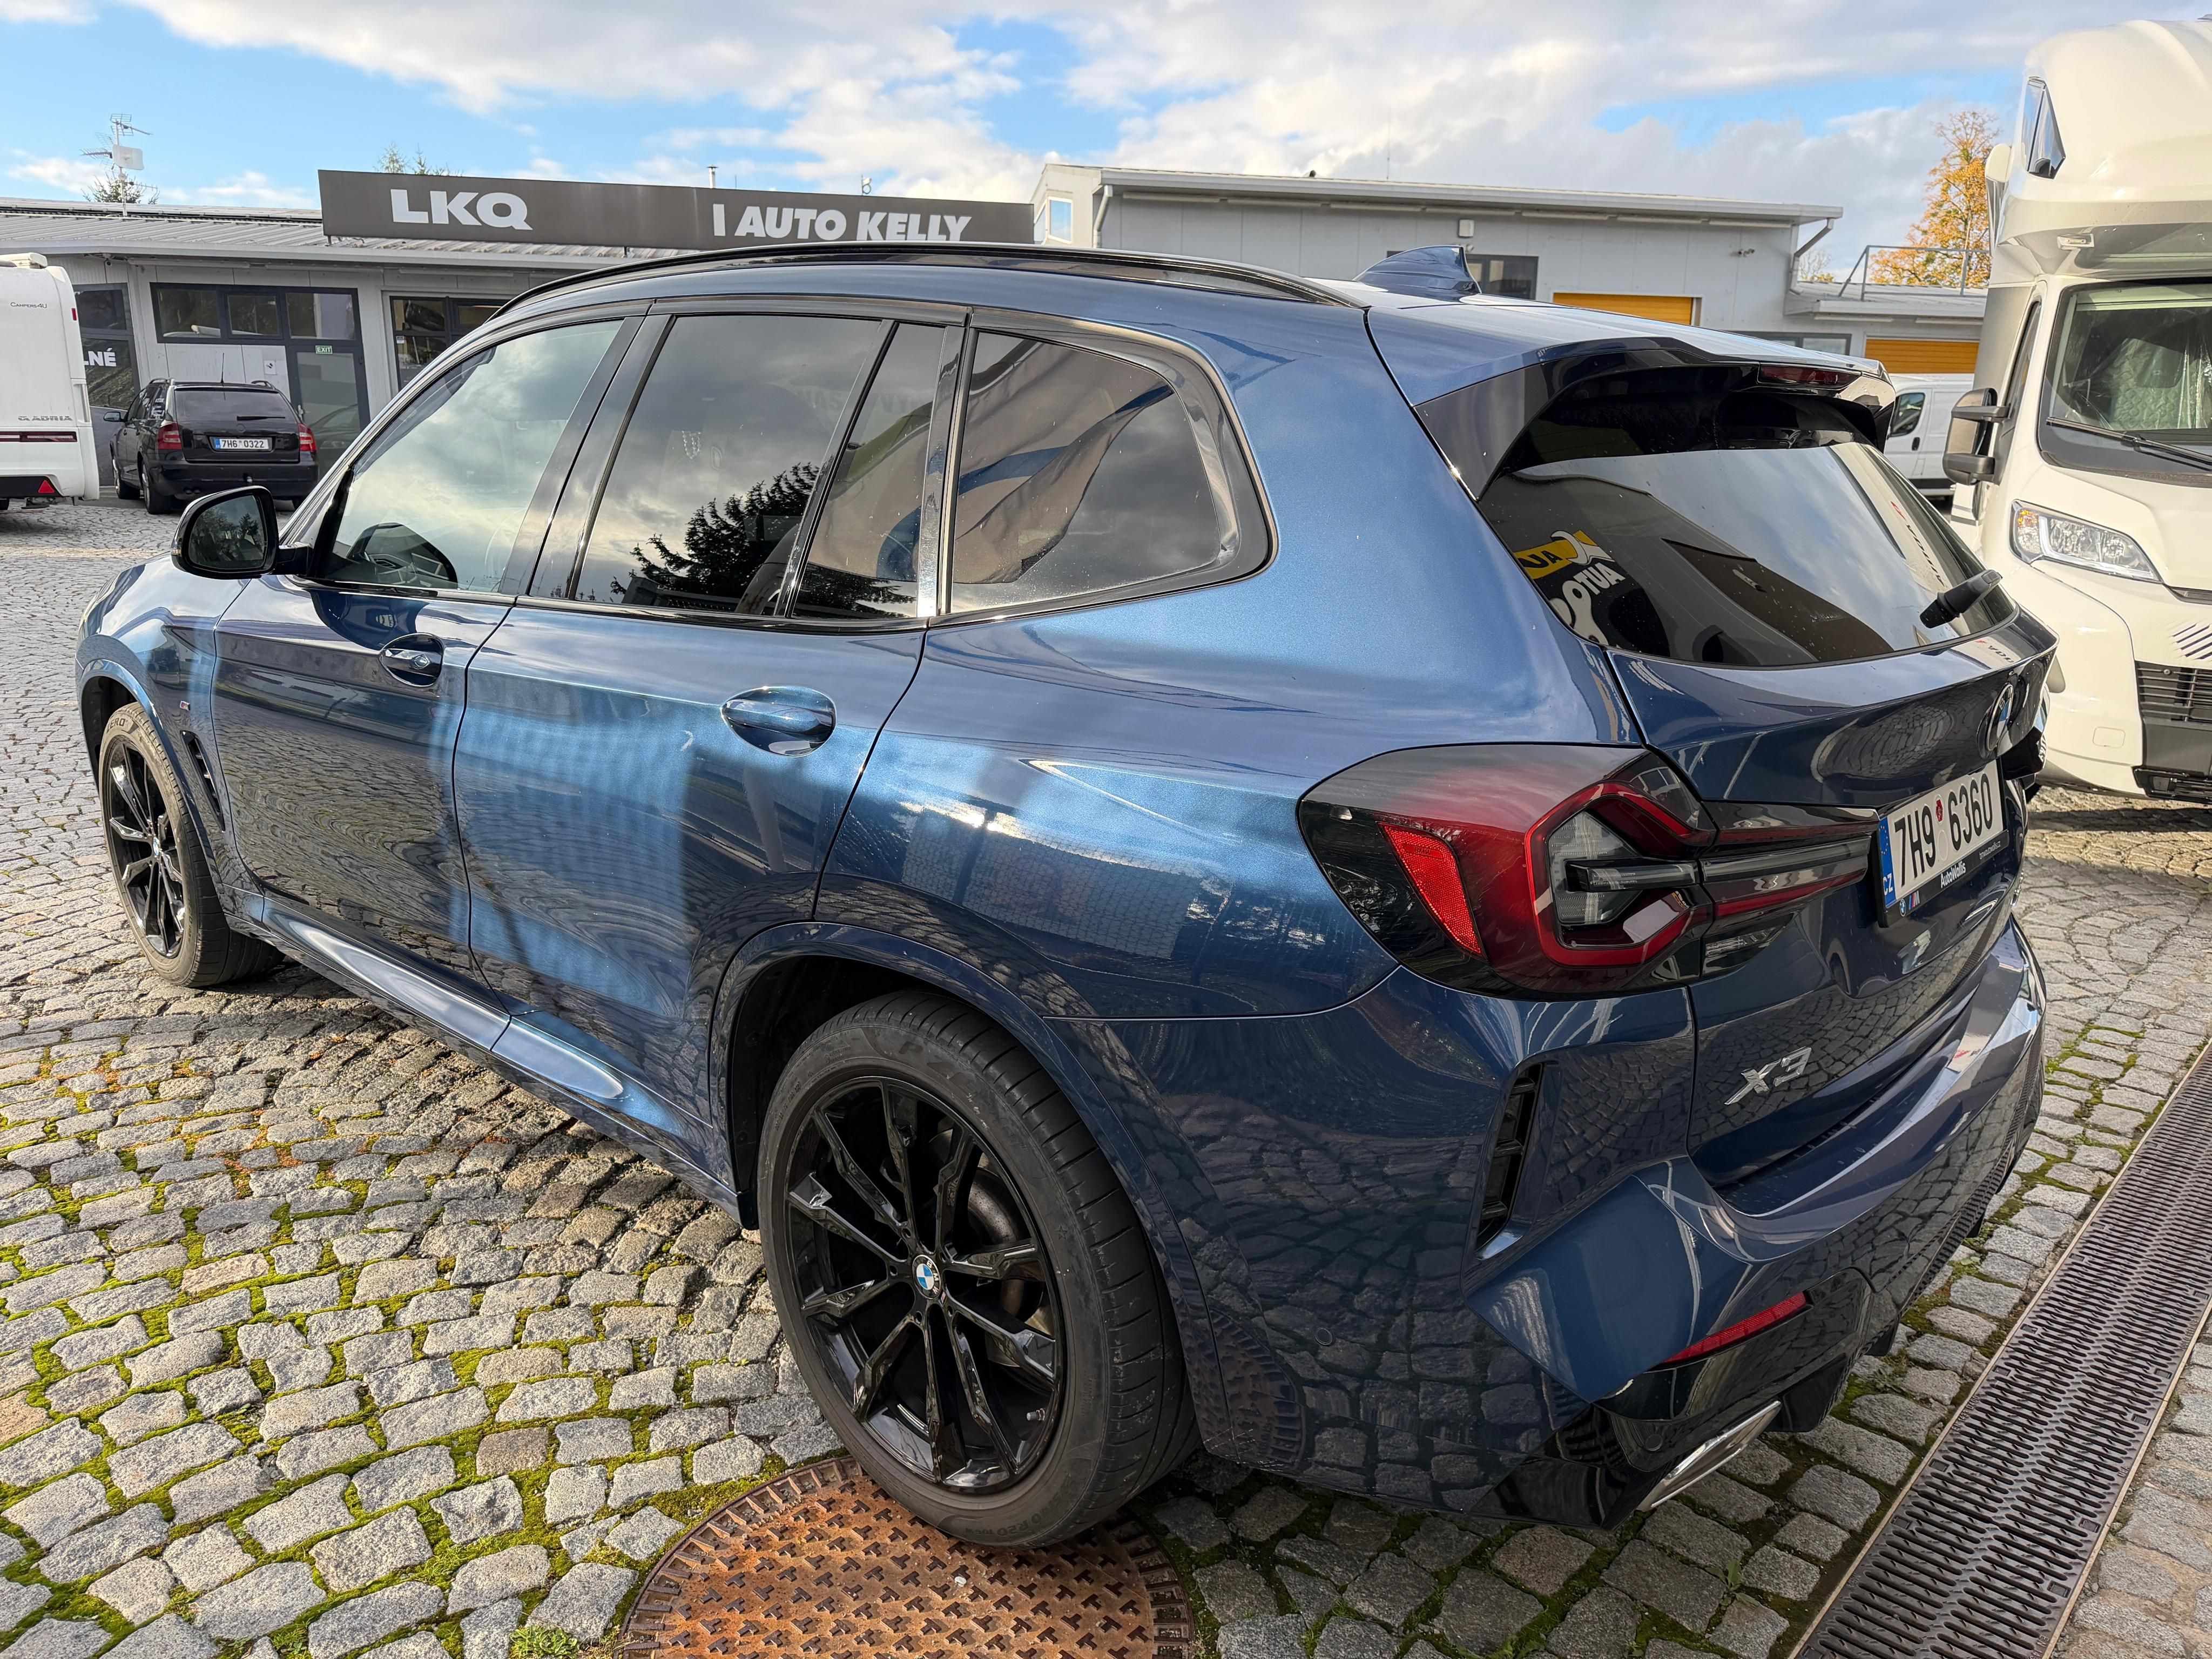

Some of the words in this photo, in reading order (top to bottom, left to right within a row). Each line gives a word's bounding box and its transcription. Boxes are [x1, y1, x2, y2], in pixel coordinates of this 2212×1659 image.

[390, 189, 533, 230] LKQ
[734, 206, 847, 241] AUTO
[855, 211, 972, 242] KELLY
[83, 348, 116, 367] NÉ
[1894, 805, 1936, 887] 7H9
[1947, 773, 1993, 851] 6360
[1883, 872, 1893, 896] CZ
[1941, 860, 1966, 888] AutoWallis
[1724, 1046, 1812, 1105] X3
